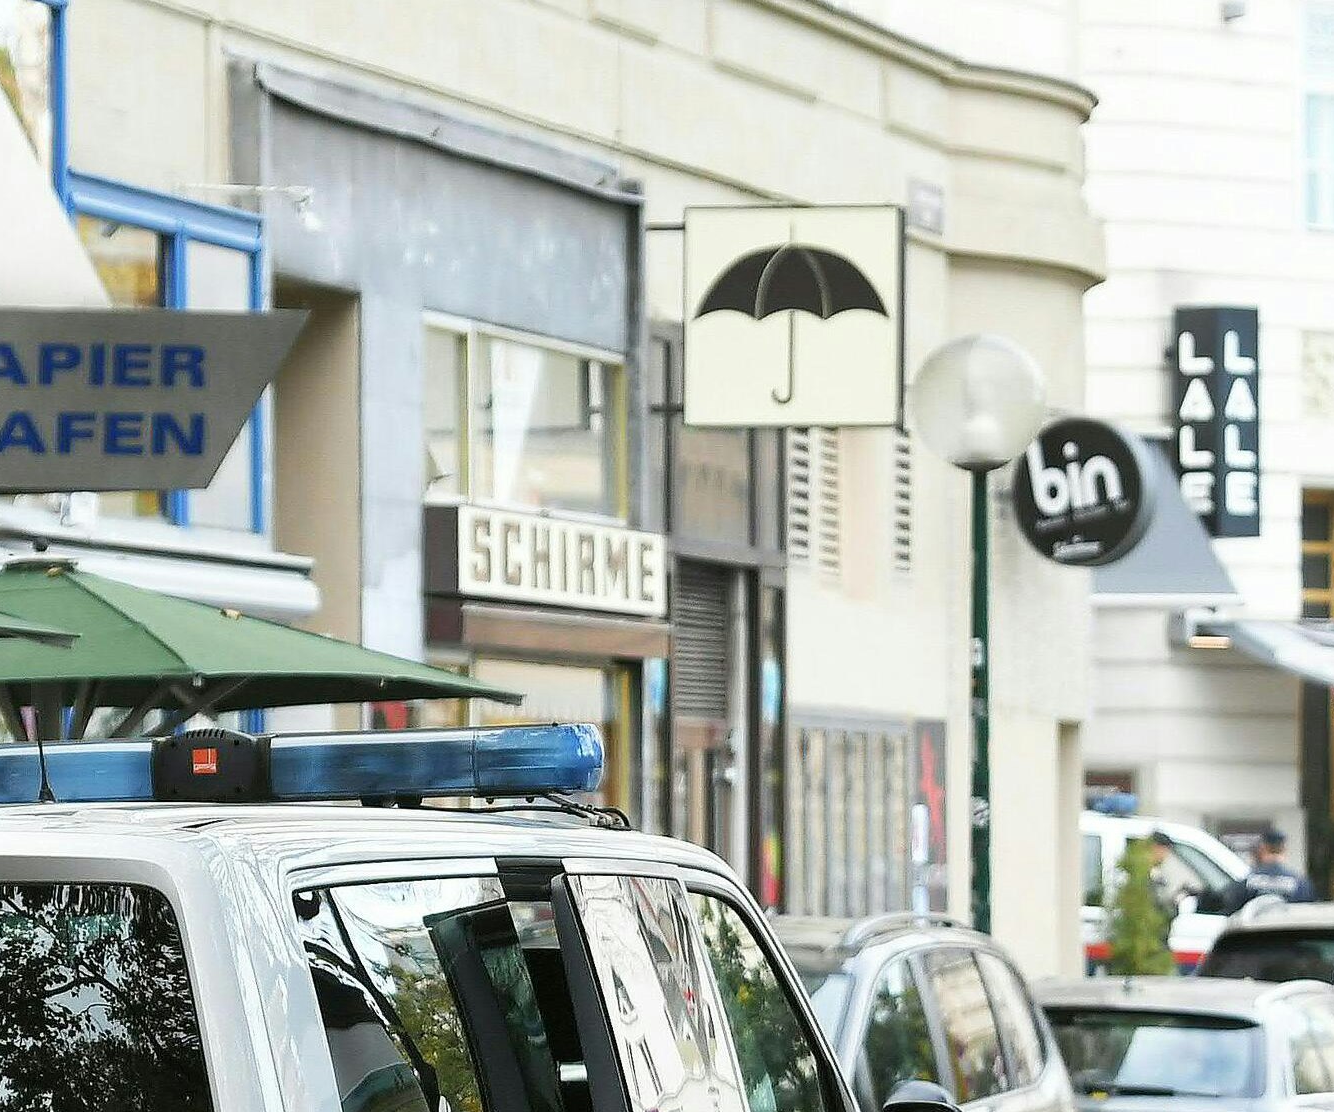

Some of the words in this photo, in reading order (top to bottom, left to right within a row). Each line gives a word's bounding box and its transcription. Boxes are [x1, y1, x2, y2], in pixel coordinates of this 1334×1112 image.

[1223, 329, 1258, 517] LALE
[1026, 438, 1124, 517] bin
[473, 518, 654, 602] SCHIRME
